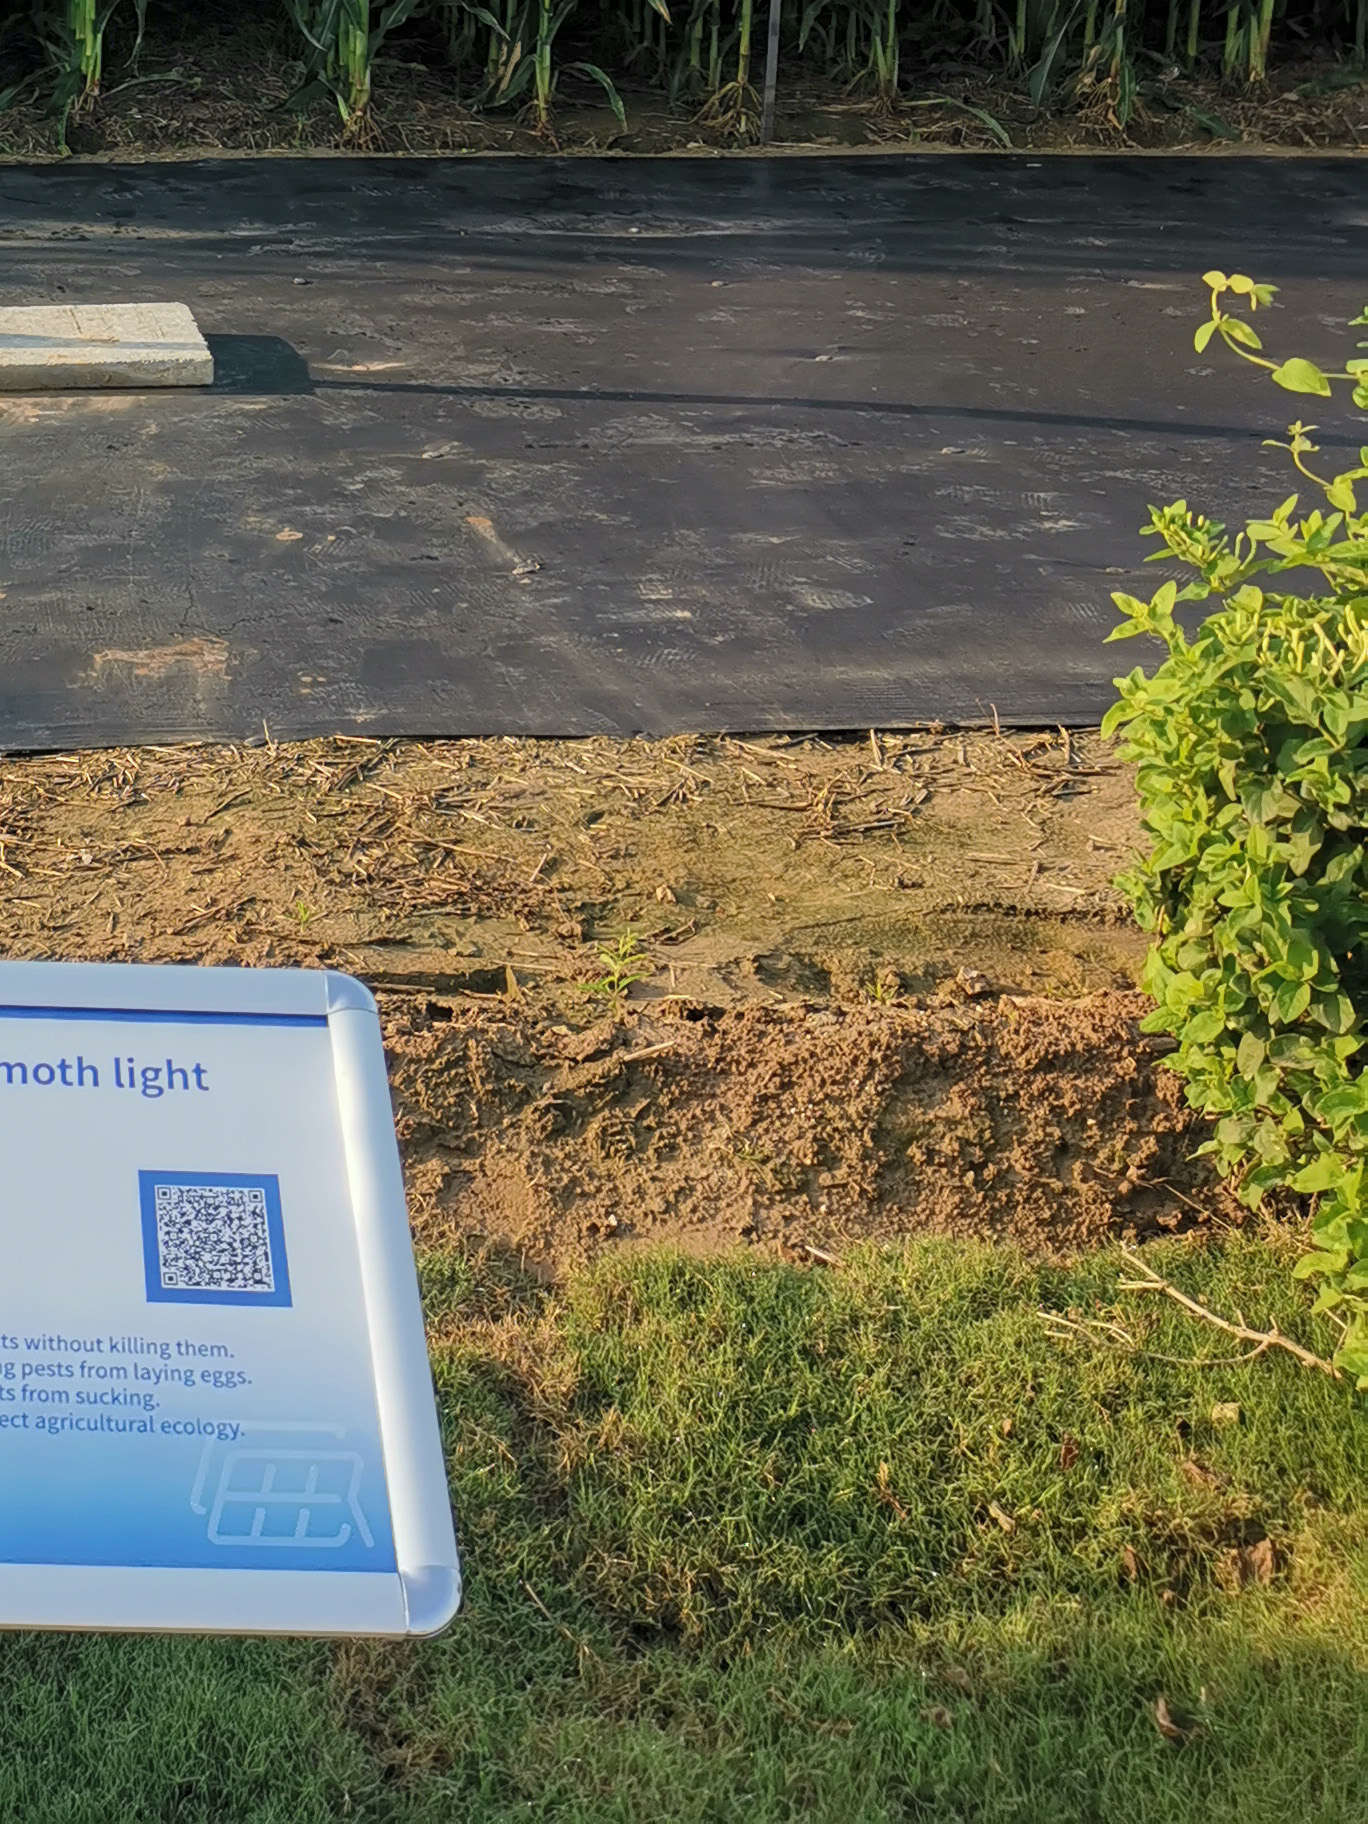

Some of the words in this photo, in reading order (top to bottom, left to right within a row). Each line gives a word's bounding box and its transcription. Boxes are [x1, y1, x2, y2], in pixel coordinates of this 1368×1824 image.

[113, 1056, 210, 1099] light
[23, 1333, 104, 1354] without
[108, 1335, 172, 1361] killing
[175, 1339, 235, 1359] them.
[21, 1361, 75, 1380] pests
[79, 1359, 128, 1380] from
[133, 1362, 196, 1388] laying
[200, 1369, 253, 1389] eggs.
[20, 1383, 70, 1404] from
[75, 1387, 161, 1413] sucking.
[35, 1412, 155, 1435] agricultural
[160, 1417, 246, 1441] ecology.
